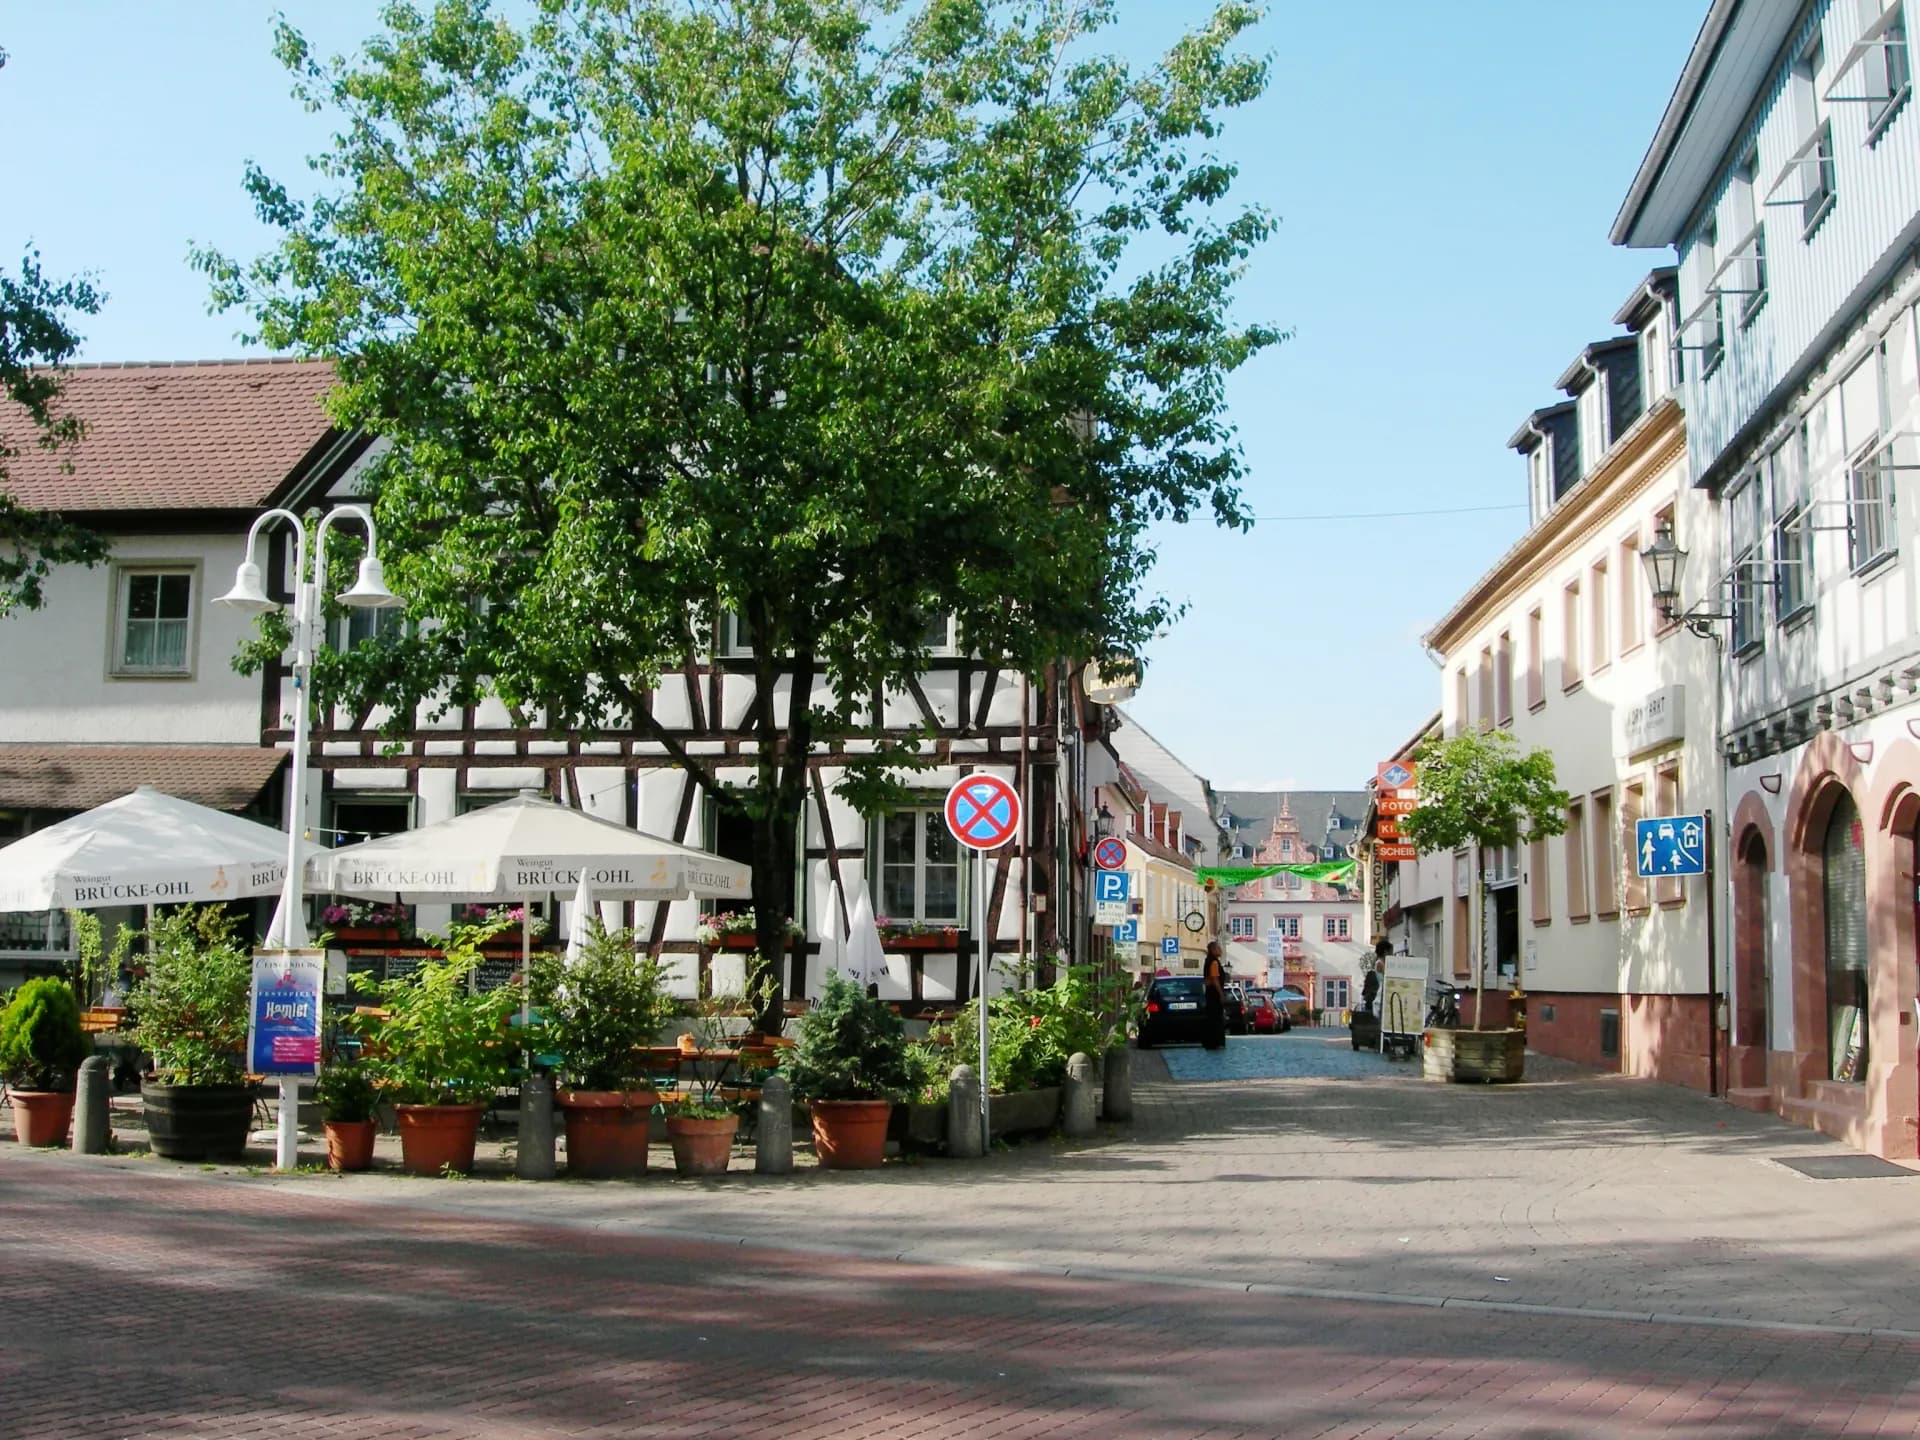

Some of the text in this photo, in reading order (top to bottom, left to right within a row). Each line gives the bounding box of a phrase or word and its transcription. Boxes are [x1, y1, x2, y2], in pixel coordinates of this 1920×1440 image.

[1381, 801, 1413, 811] FOTO
[1380, 847, 1415, 856] SCHEIB
[517, 858, 553, 868] Weingut
[73, 874, 112, 885] Weingut
[517, 867, 634, 885] BRÜCK-OHL
[75, 881, 194, 901] BRÜCKE-OHL
[1103, 875, 1122, 899] P
[1120, 922, 1132, 941] P
[1166, 939, 1176, 953] P
[266, 1001, 308, 1019] Hamlet
